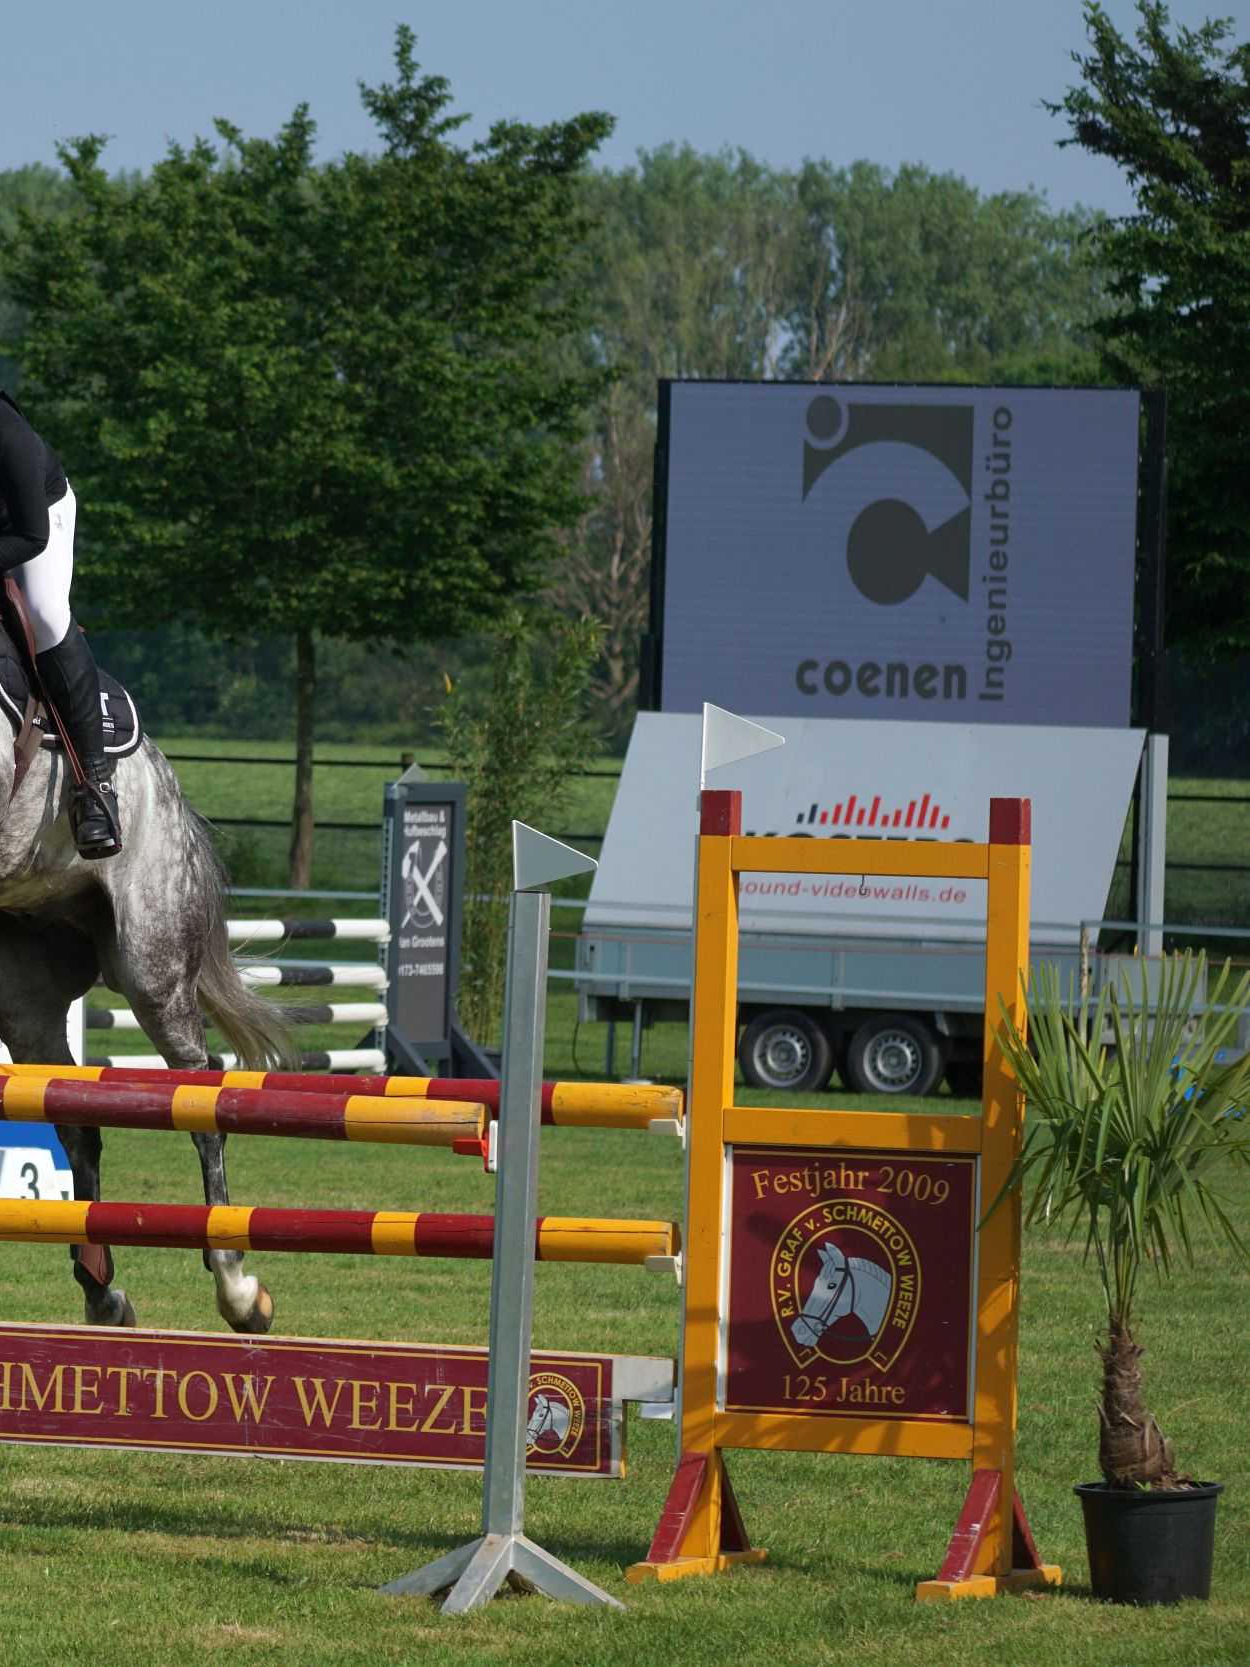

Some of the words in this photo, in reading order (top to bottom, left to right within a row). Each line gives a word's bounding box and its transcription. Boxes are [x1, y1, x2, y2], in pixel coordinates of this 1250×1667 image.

[979, 405, 1013, 701] Ingenieurbüro
[795, 659, 967, 699] coenen
[739, 879, 967, 904] ound-videowalls.de
[21, 1162, 40, 1200] 3
[751, 1162, 869, 1200] Festjahr
[877, 1166, 950, 1206] 2009
[777, 1228, 803, 1276] GRAF
[822, 1205, 912, 1267] SCHMETTOW
[892, 1273, 914, 1330] WEEZE
[292, 1376, 488, 1436] WEEZE
[782, 1375, 827, 1400] 125
[836, 1377, 905, 1404] Jahre
